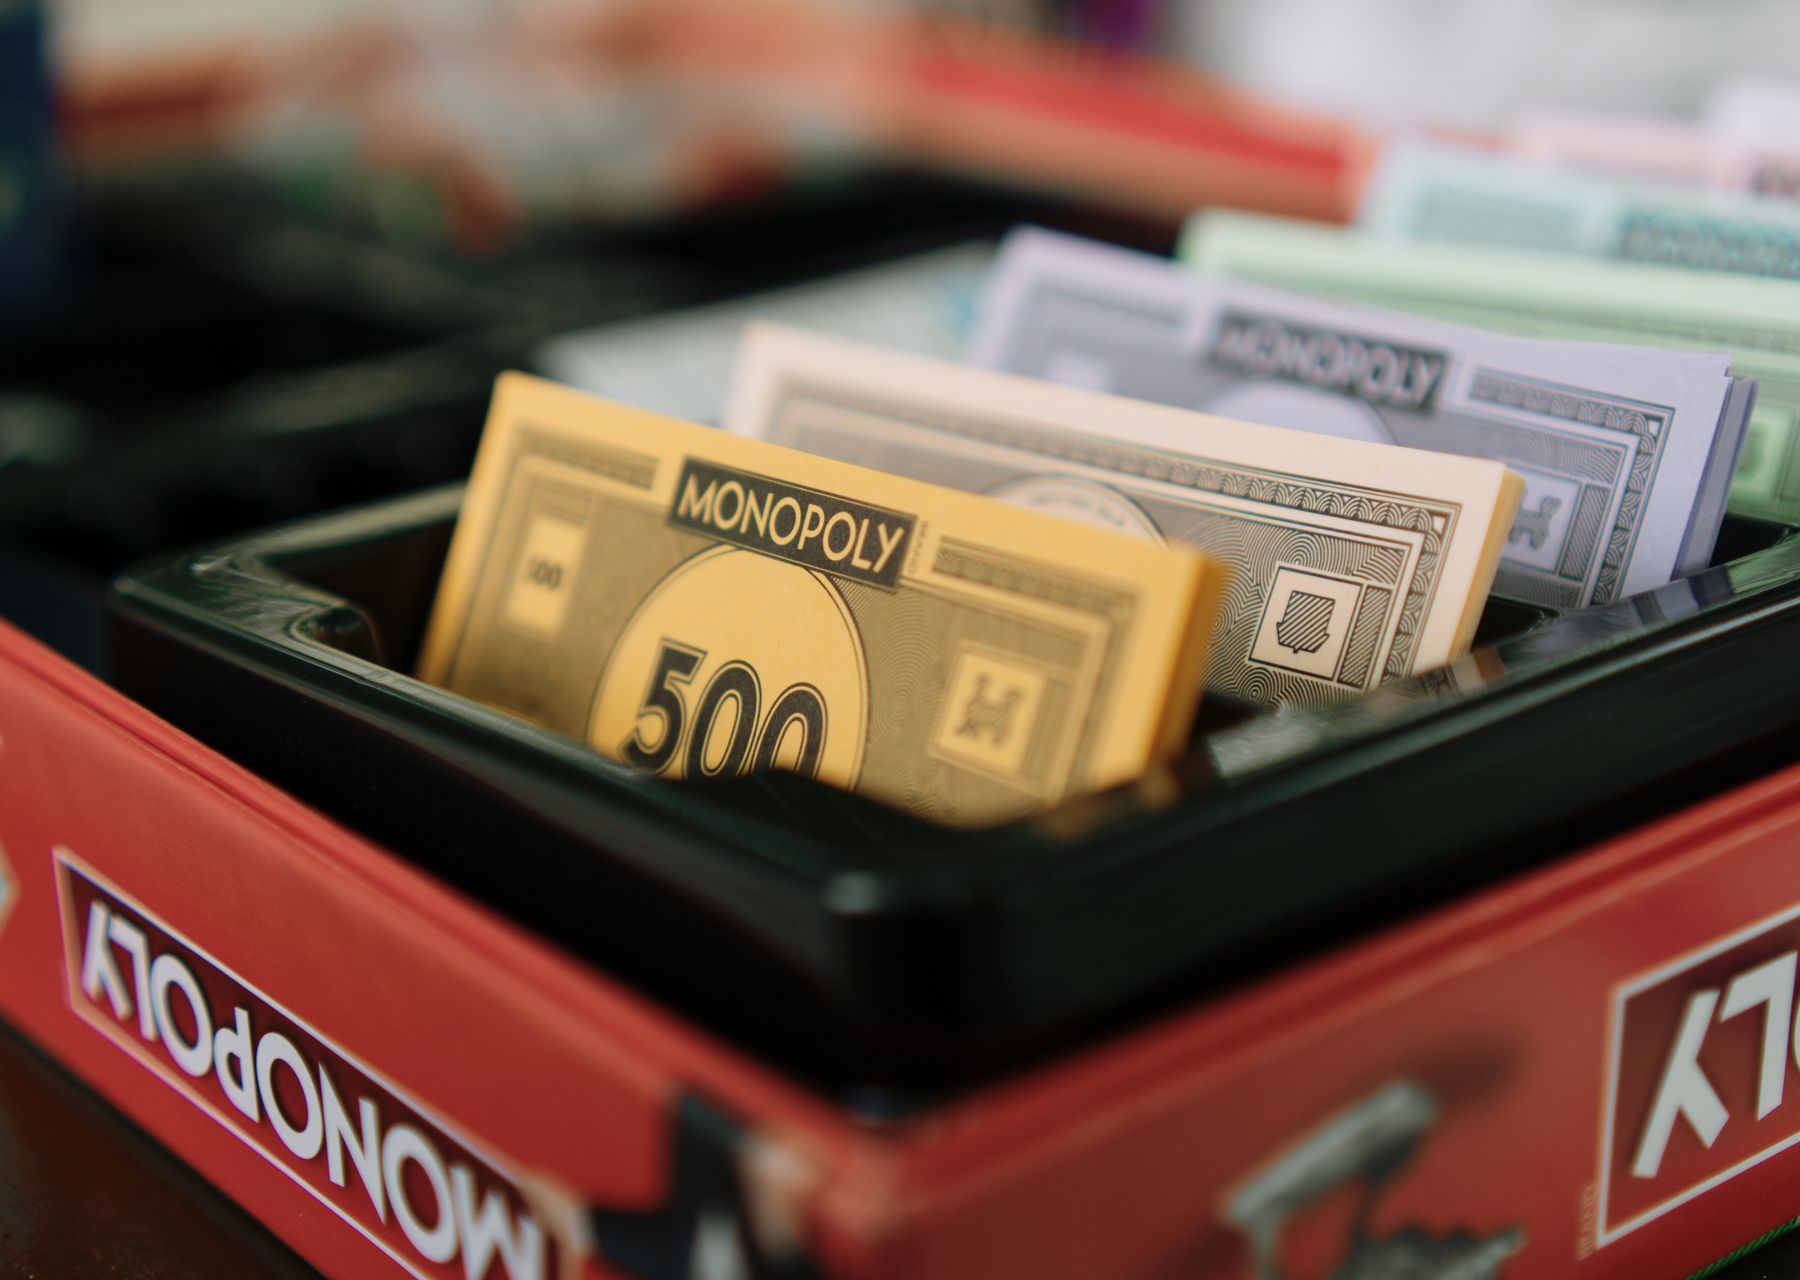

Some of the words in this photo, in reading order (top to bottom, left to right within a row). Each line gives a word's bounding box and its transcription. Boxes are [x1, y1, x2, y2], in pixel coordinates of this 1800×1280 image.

[678, 472, 904, 574] MONOPOLY
[618, 636, 828, 781] 500
[80, 898, 543, 1280] MONOPOLY
[1631, 950, 1800, 1178] LY
